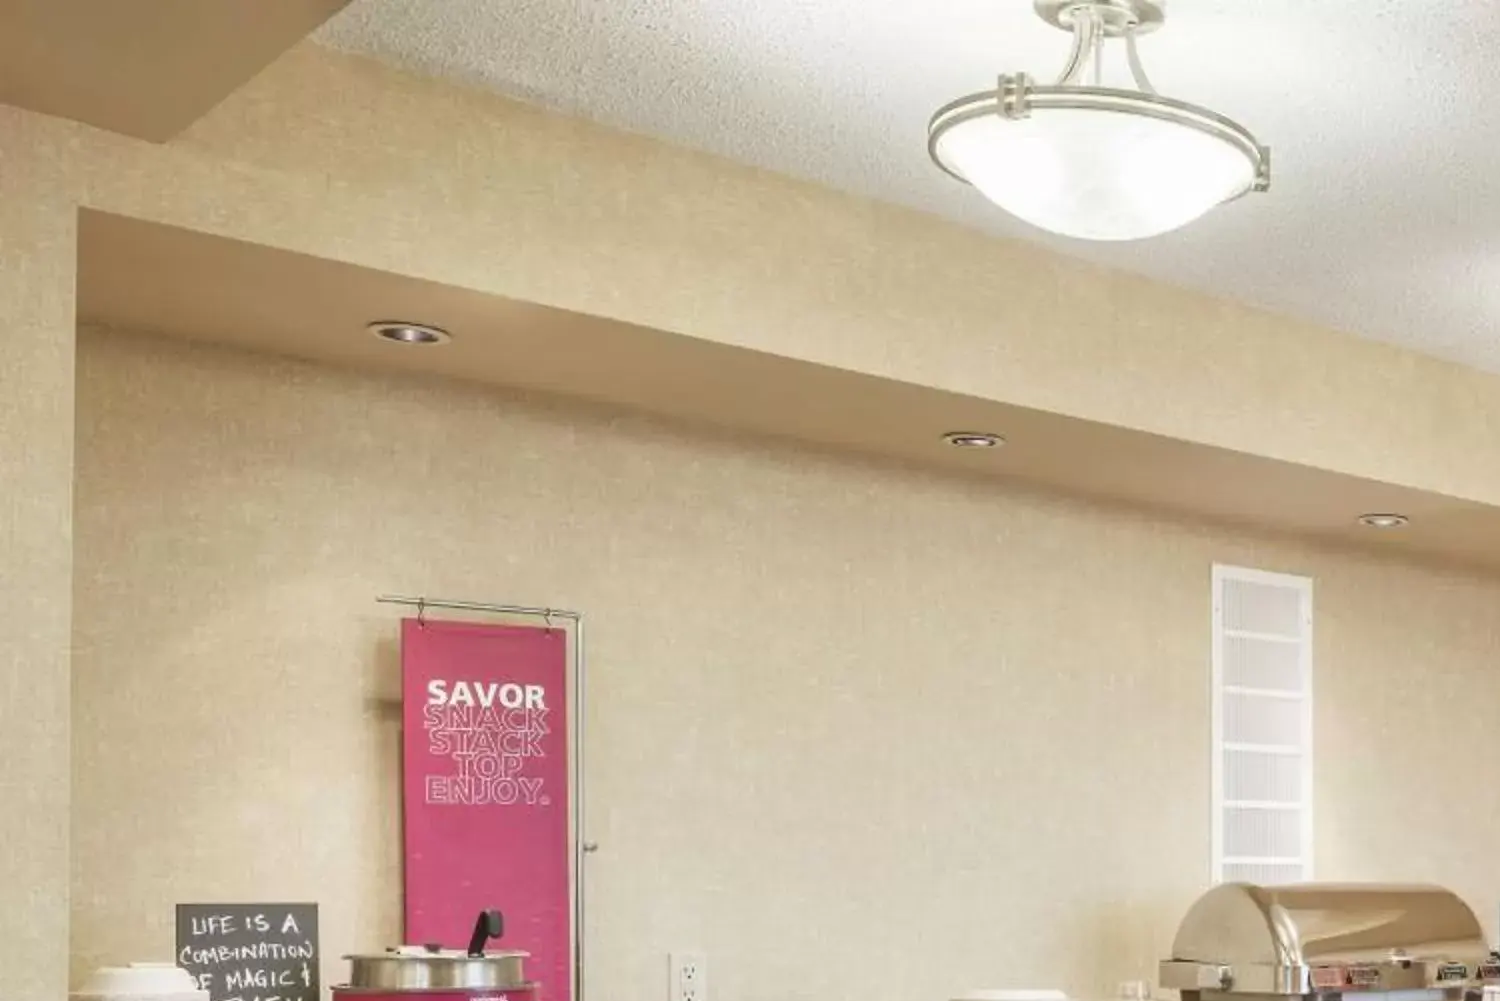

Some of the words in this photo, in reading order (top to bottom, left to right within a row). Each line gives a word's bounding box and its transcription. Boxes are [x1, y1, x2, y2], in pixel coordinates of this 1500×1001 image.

[427, 679, 546, 709] SAVOR
[423, 703, 551, 734] SNACK
[429, 728, 546, 757] STACK
[451, 752, 523, 780] TOP
[425, 775, 551, 805] ENJOY.
[191, 915, 238, 936] LIFE
[245, 913, 271, 932] IS
[280, 913, 300, 934] A
[179, 940, 314, 966] COMBINATION
[225, 967, 296, 993] MAGIC
